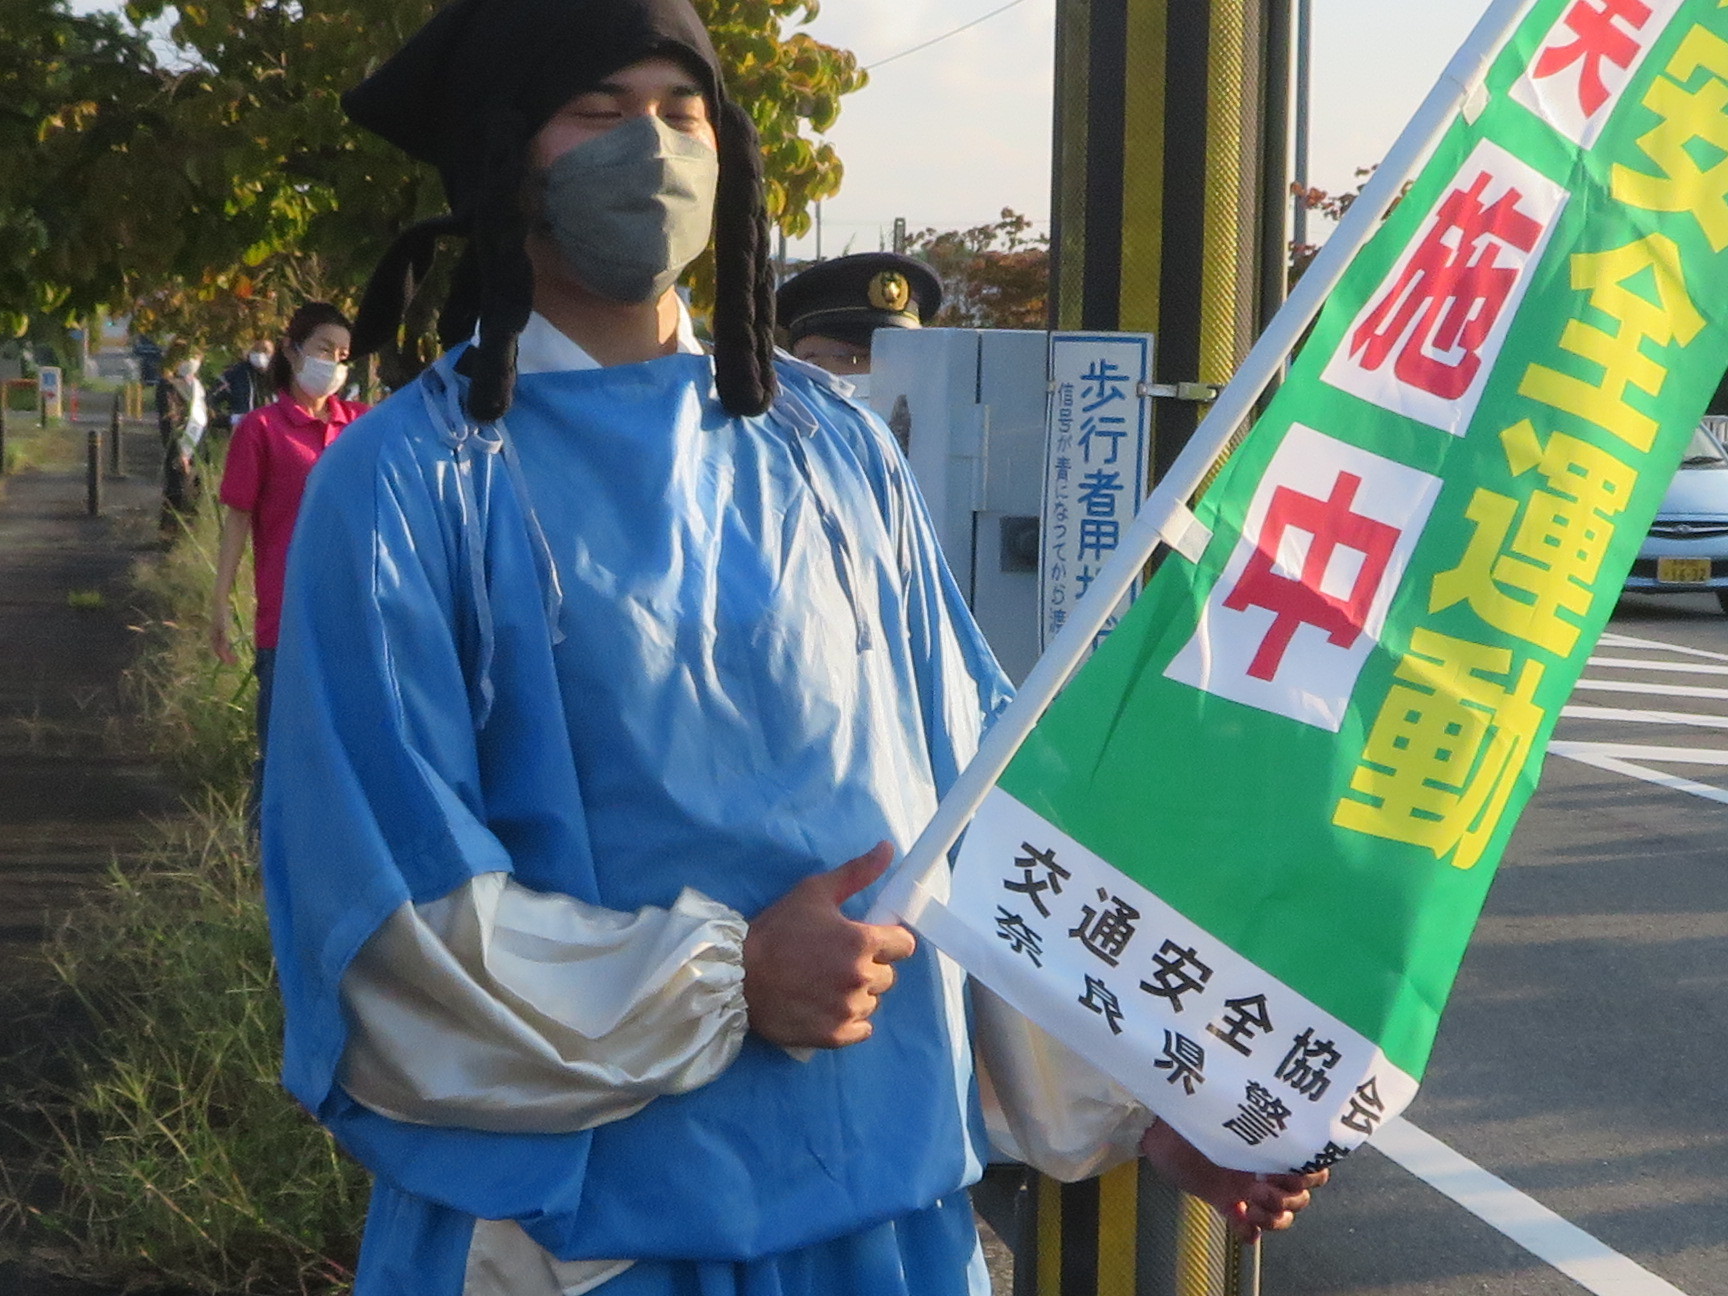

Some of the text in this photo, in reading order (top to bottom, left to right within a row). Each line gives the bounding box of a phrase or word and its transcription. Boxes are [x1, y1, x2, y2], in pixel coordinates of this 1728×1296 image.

[1075, 359, 1130, 652] 歩行者用
[1002, 840, 1386, 1136] 交通安全協会
